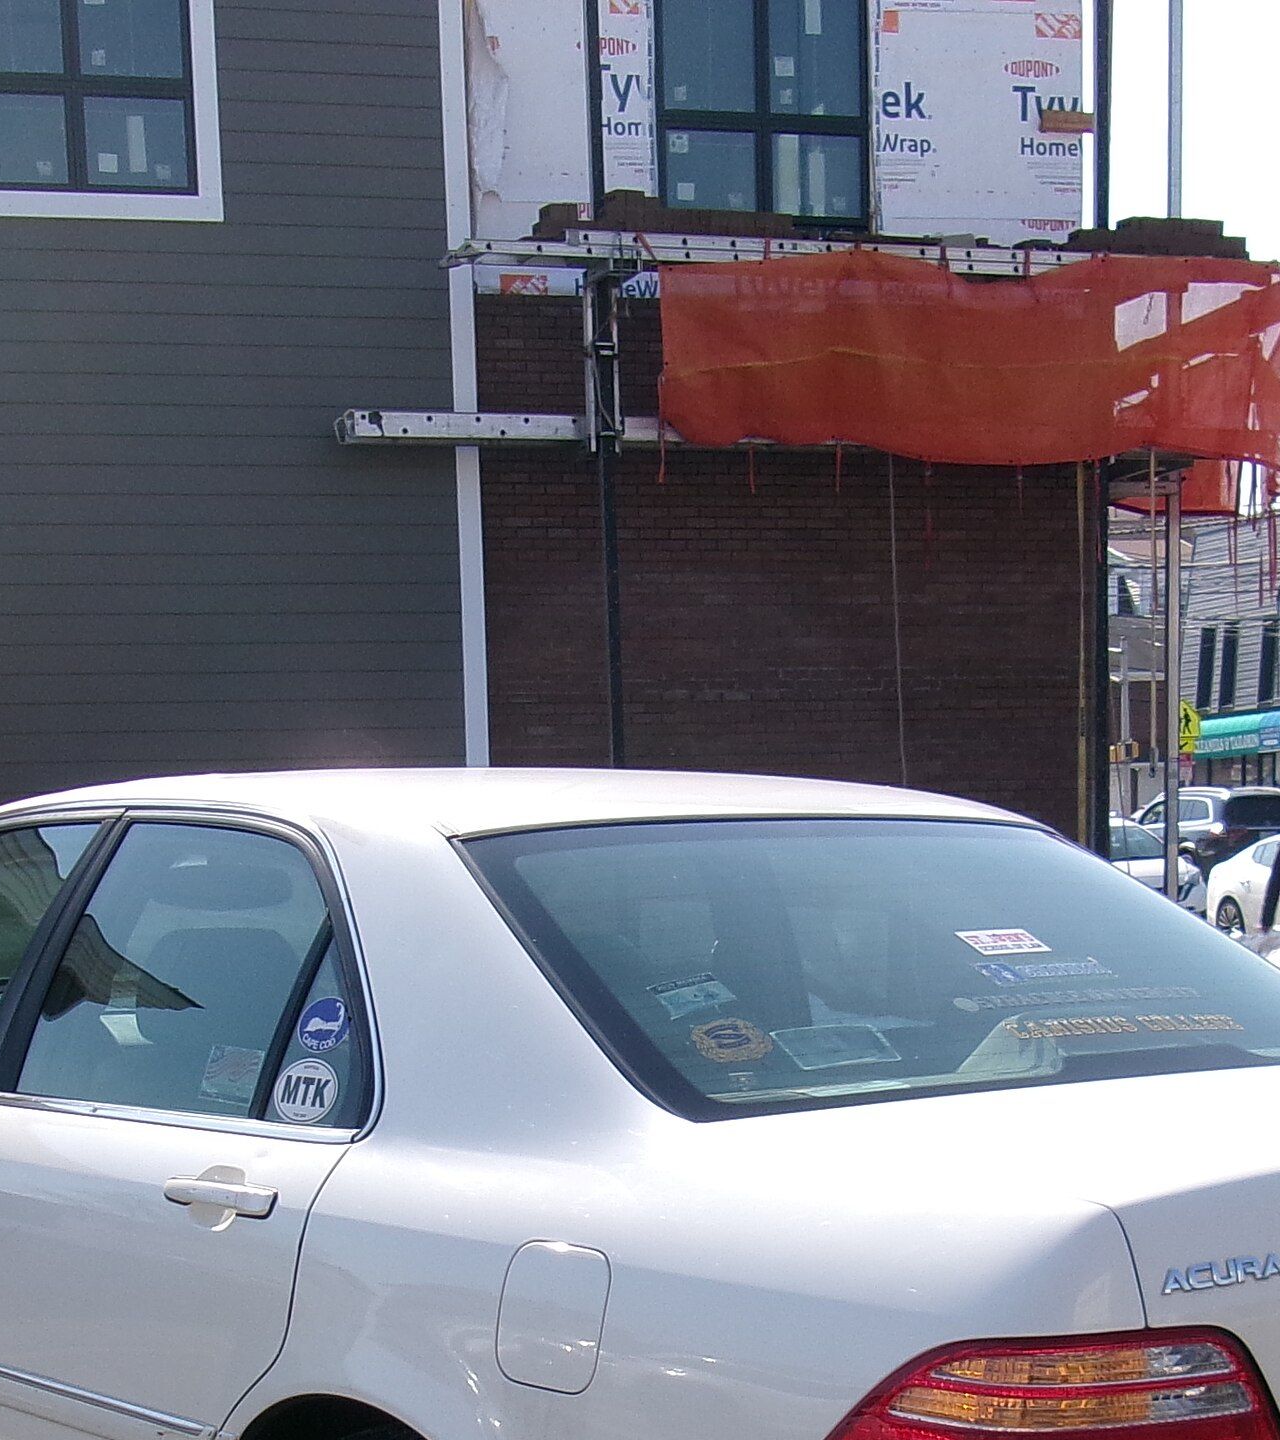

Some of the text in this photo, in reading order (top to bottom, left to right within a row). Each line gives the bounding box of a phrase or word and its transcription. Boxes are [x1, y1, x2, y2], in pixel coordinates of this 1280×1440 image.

[1010, 59, 1054, 79] DUPONT
[1020, 137, 1082, 157] Home
[302, 1033, 336, 1050] CAPE COD
[280, 1074, 332, 1108] MTK
